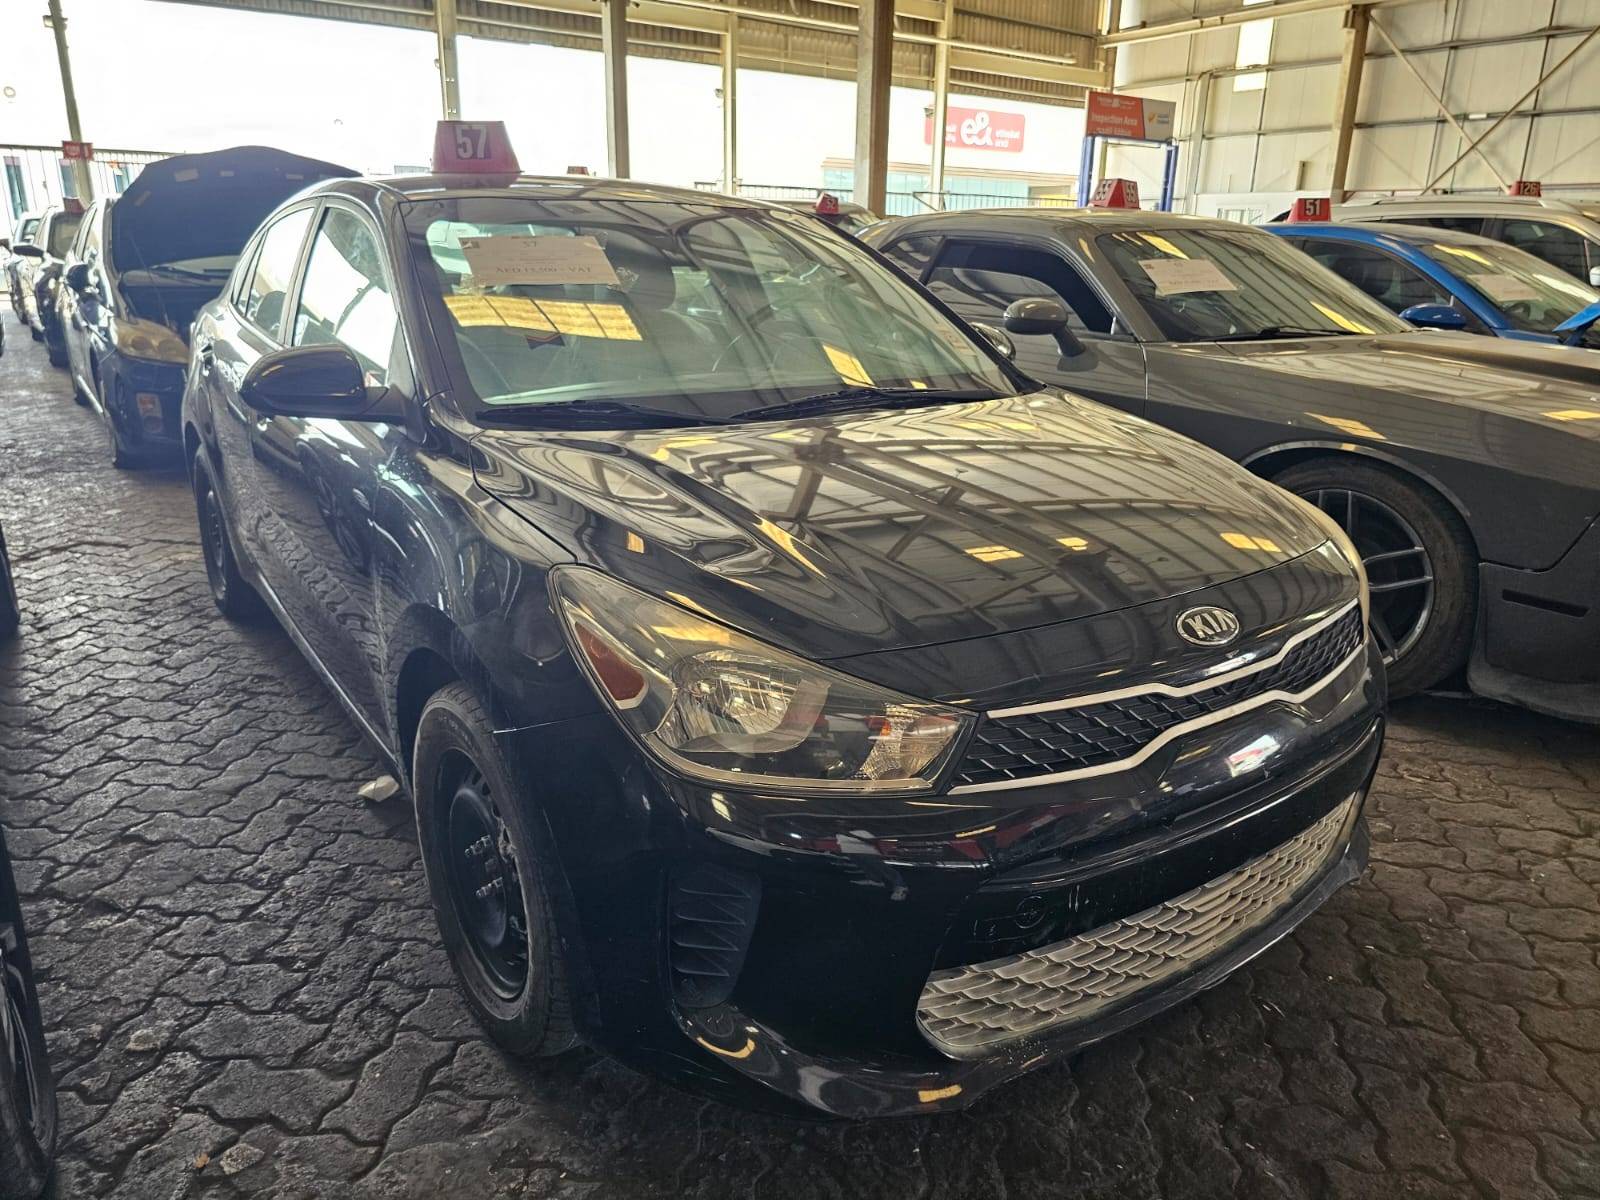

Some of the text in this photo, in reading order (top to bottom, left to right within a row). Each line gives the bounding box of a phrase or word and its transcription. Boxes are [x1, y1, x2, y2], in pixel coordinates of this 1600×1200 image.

[1091, 112, 1138, 126] Inspection Area
[456, 124, 488, 160] 57
[1095, 180, 1113, 201] 55
[1126, 181, 1137, 203] 55
[1518, 182, 1537, 195] 126
[1304, 199, 1321, 216] 51
[1184, 610, 1236, 639] KIA
